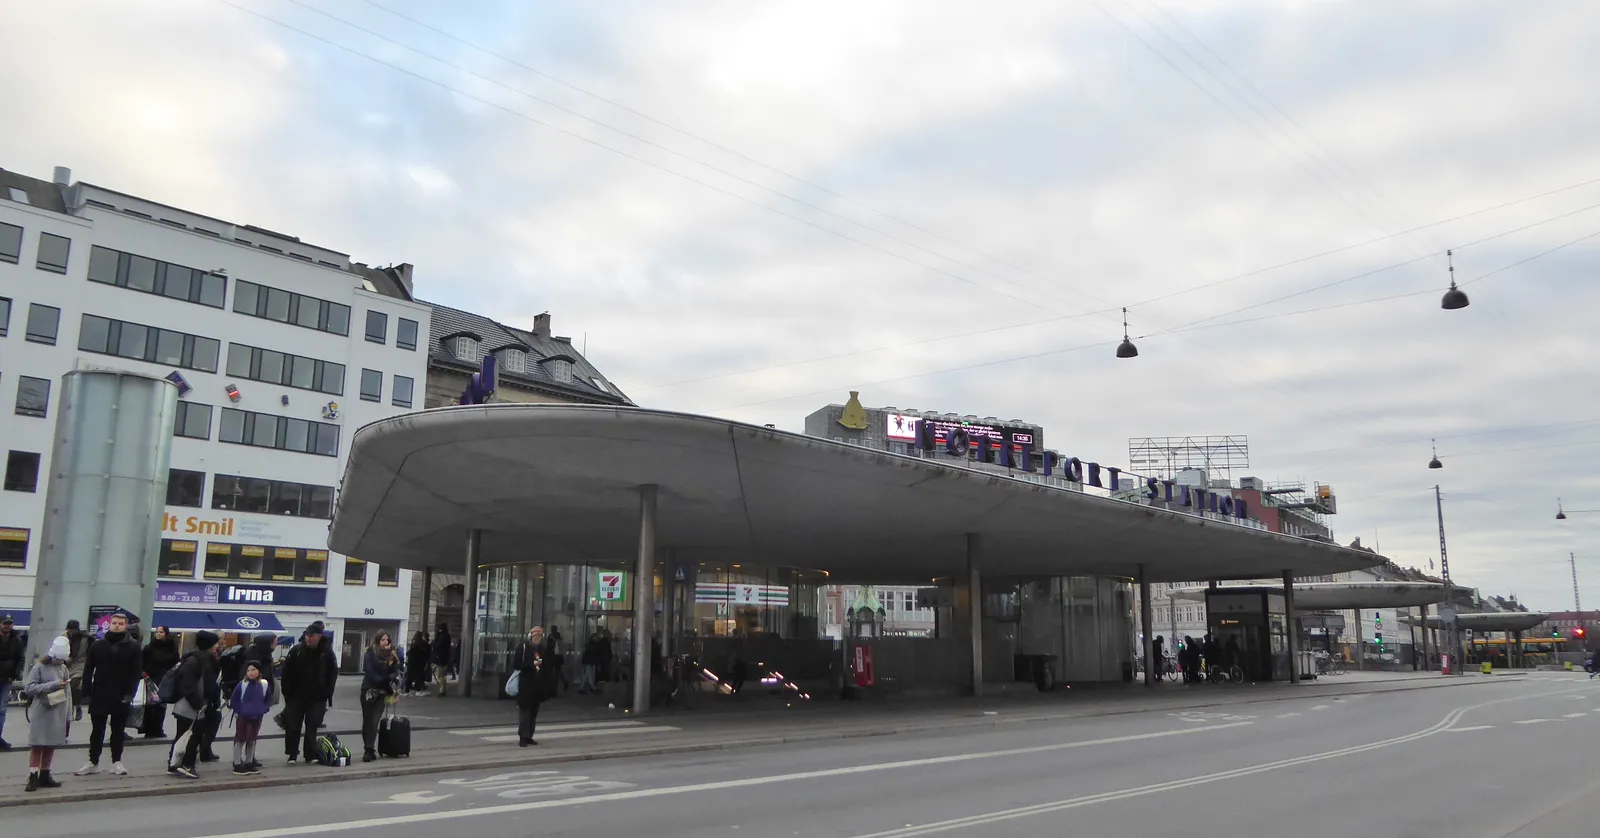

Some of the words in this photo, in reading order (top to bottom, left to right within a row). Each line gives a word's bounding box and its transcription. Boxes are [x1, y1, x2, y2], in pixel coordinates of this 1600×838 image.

[185, 515, 235, 536] Smil
[228, 585, 274, 602] Irma
[364, 607, 375, 616] 80
